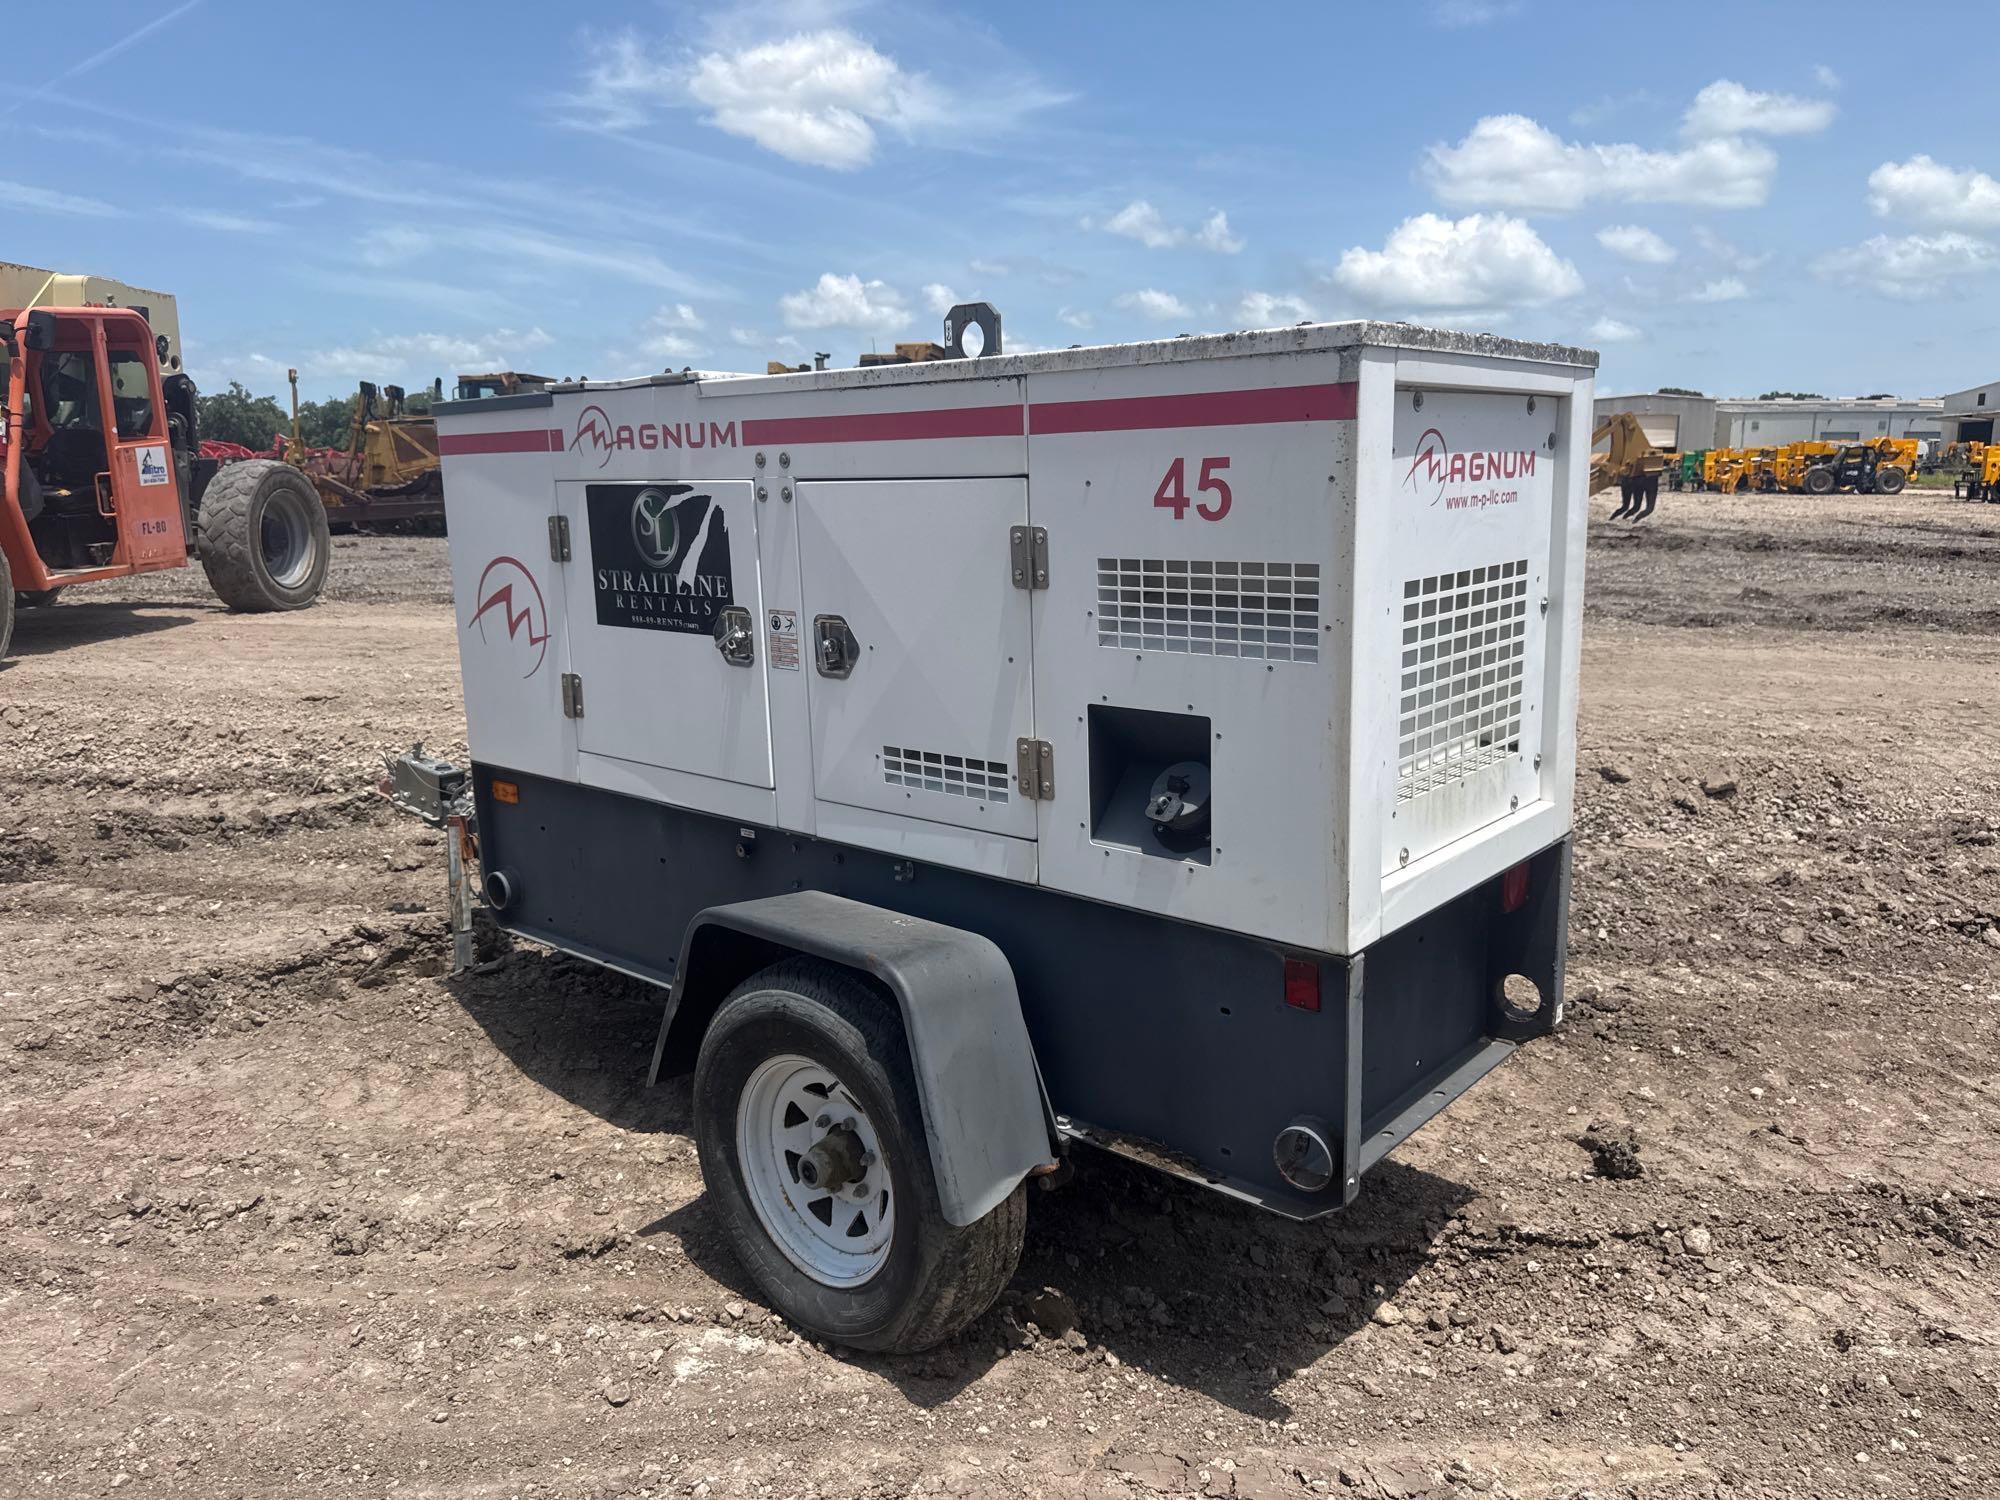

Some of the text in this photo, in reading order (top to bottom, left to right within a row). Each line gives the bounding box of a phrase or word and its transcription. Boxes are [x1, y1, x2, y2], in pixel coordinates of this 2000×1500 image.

[569, 417, 737, 453] MAGNUM
[1402, 444, 1536, 485] MAGNUM
[1153, 456, 1232, 521] 45
[1446, 490, 1518, 510] www.m-p-llc.com
[616, 594, 712, 616] RENTALS
